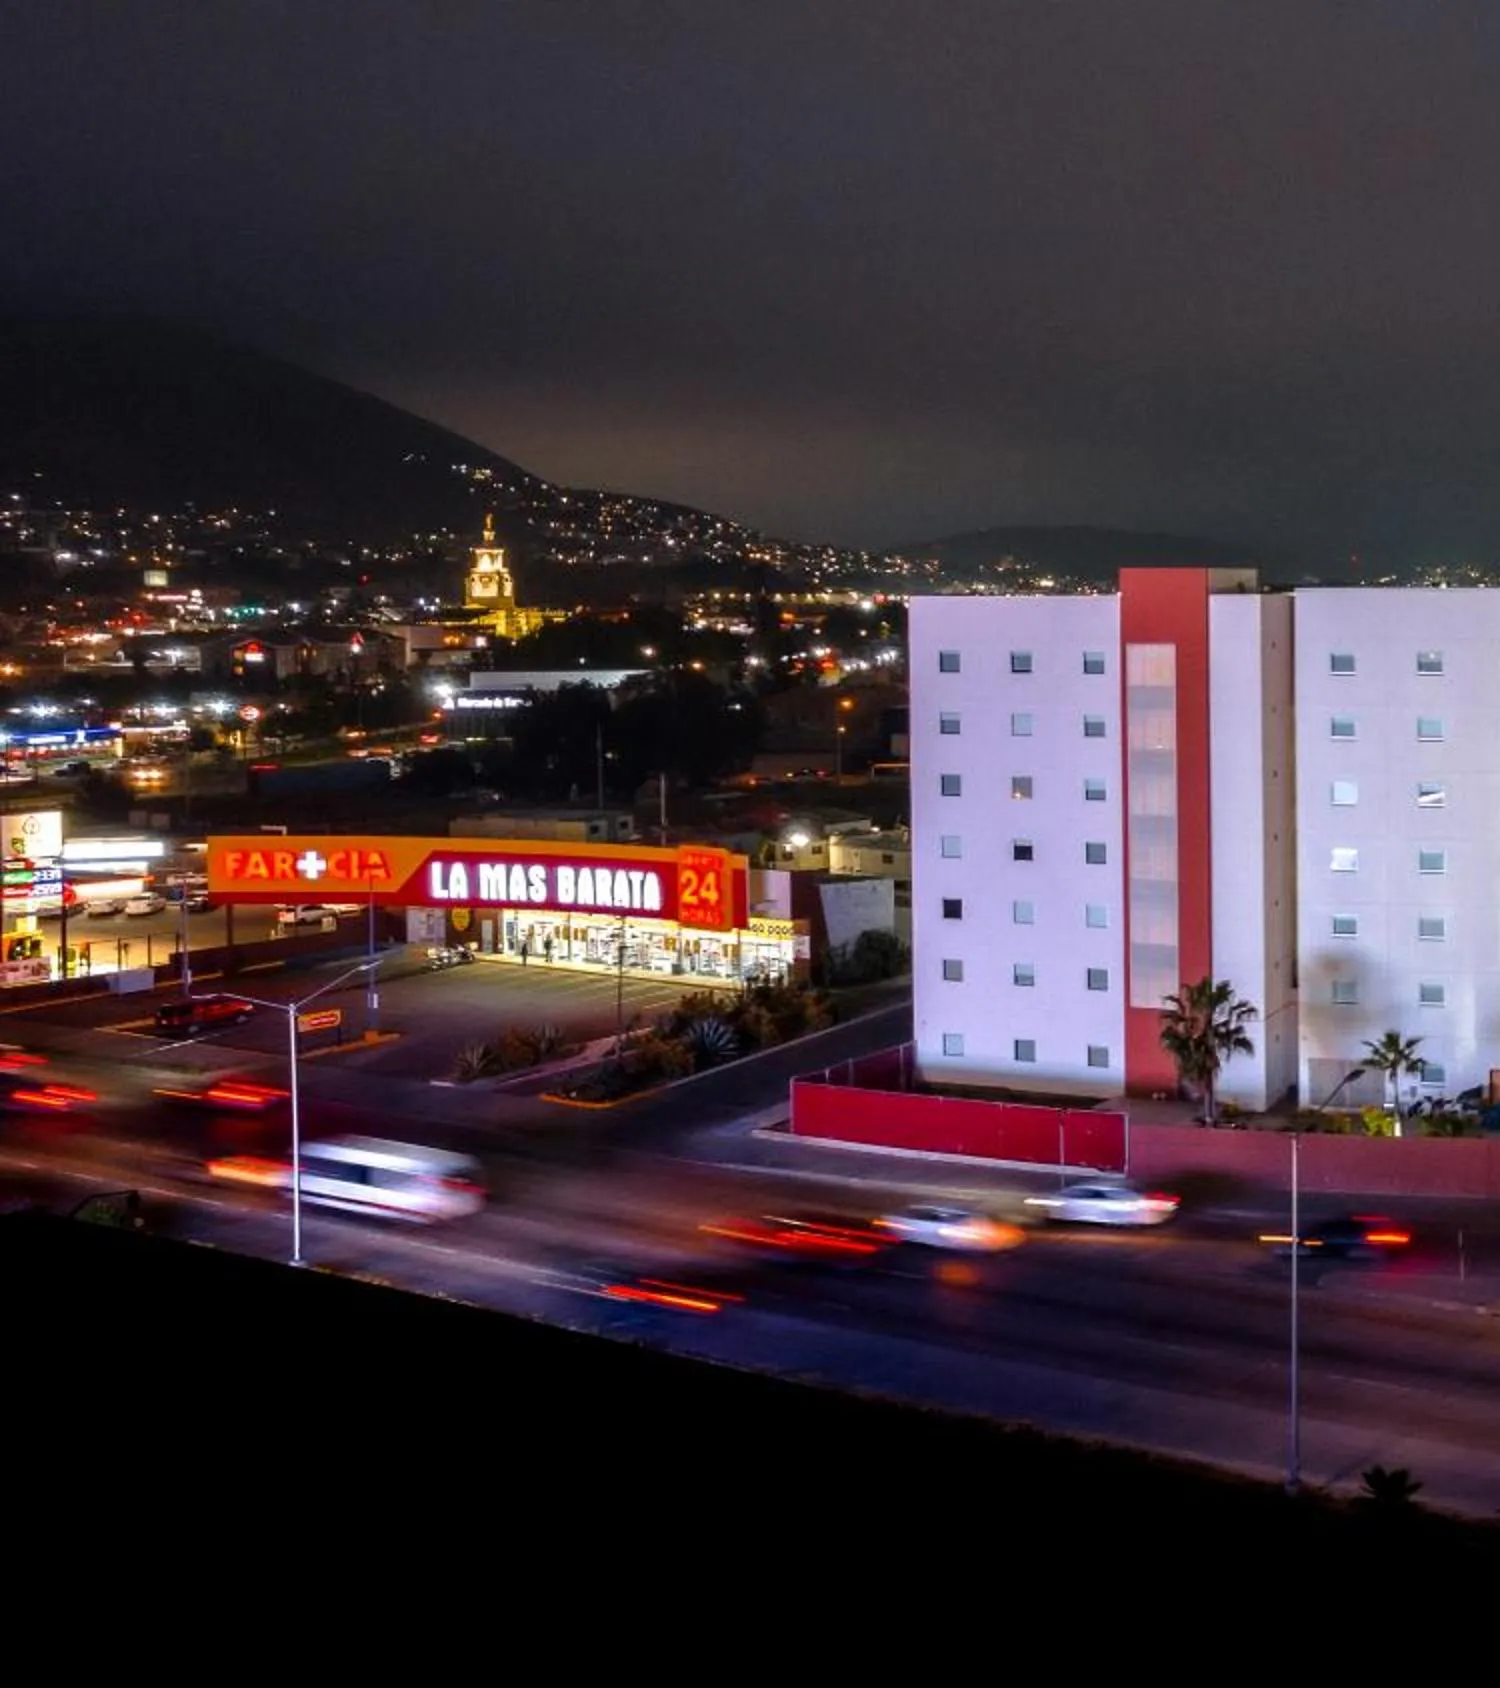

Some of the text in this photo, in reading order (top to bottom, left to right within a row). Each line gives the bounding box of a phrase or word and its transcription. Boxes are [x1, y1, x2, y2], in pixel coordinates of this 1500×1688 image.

[431, 861, 661, 911] LA MAS BARATA
[681, 869, 719, 905] 24
